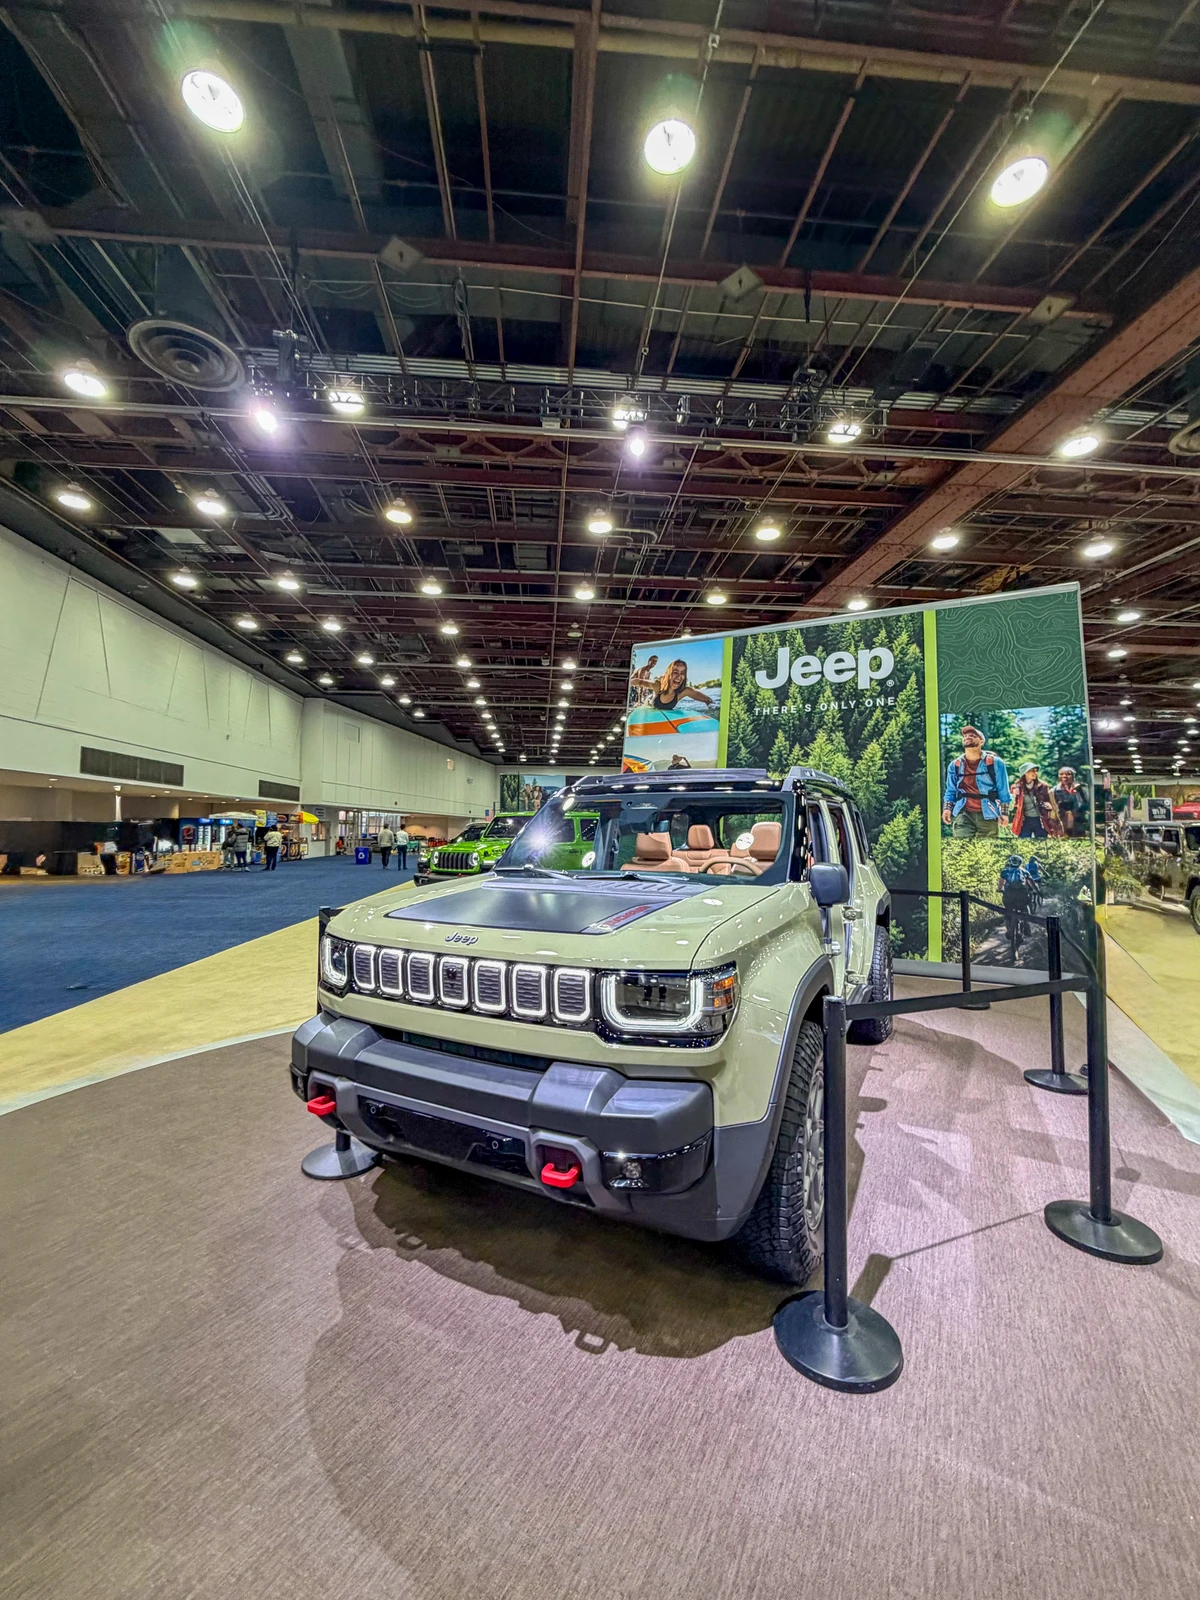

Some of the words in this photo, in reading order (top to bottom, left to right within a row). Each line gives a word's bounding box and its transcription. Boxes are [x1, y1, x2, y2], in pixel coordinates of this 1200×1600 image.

[755, 647, 895, 689] Jeep
[754, 704, 812, 715] THERE'S
[819, 701, 856, 711] ONLY
[865, 697, 895, 707] ONE
[445, 931, 479, 946] Jeep
